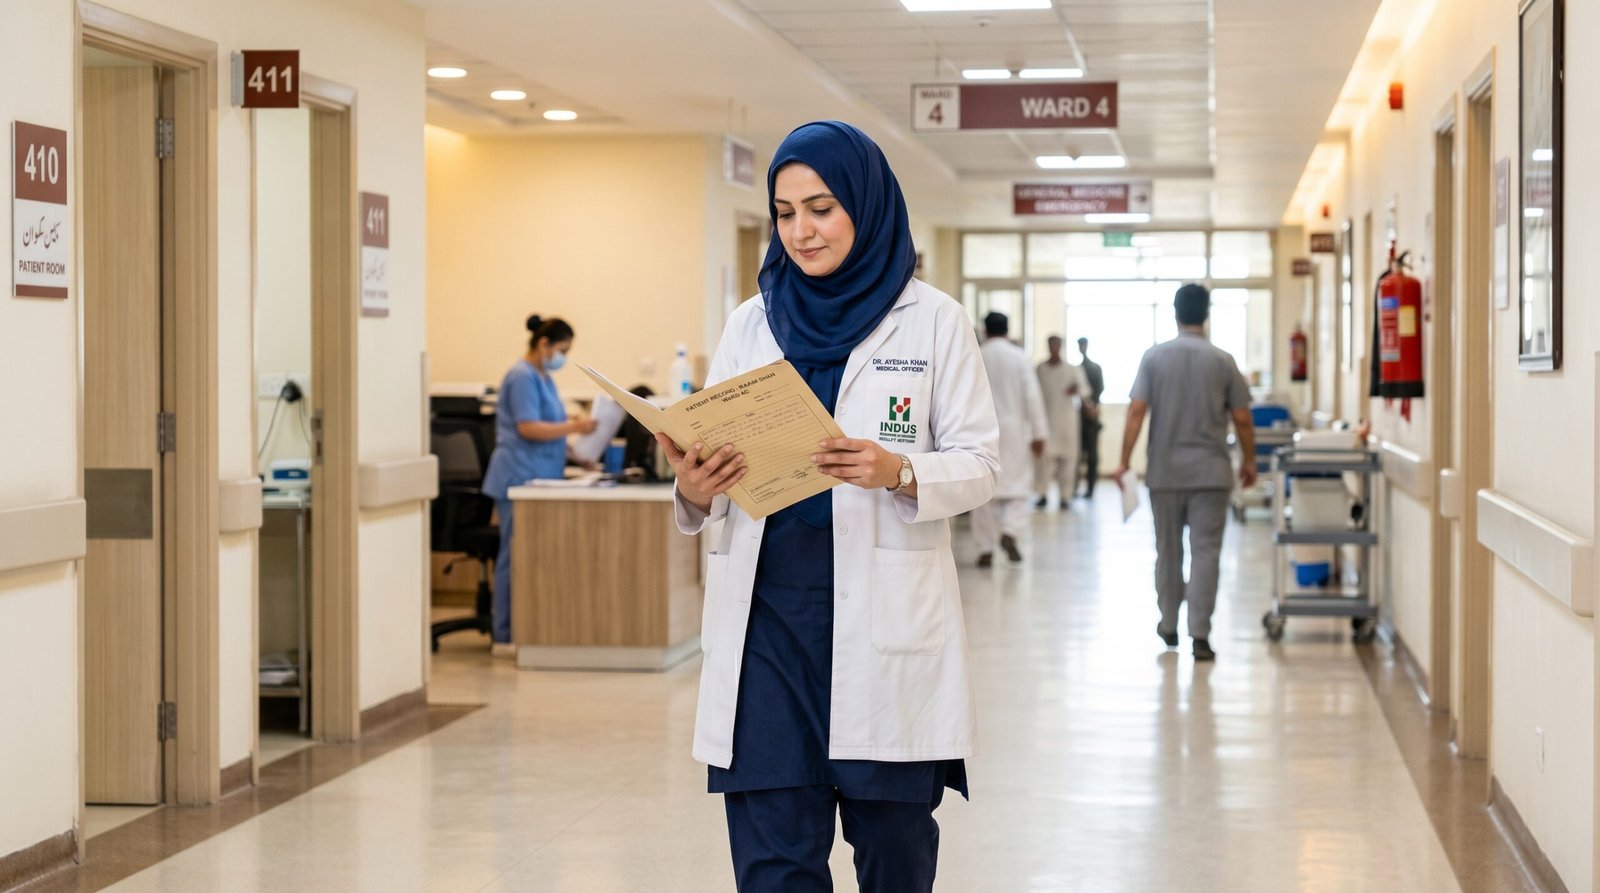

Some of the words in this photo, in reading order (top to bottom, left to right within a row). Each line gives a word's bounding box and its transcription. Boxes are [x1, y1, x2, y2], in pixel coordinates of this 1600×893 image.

[248, 65, 292, 93] 411
[928, 102, 944, 125] 4
[1021, 96, 1091, 118] WARD
[1095, 96, 1110, 118] 4
[24, 143, 59, 185] 410
[366, 207, 385, 235] 411
[19, 260, 45, 273] PATIENT
[46, 262, 65, 274] ROOM
[884, 358, 909, 366] AYESHA
[910, 359, 928, 367] KHAN
[880, 421, 917, 435] INDUS
